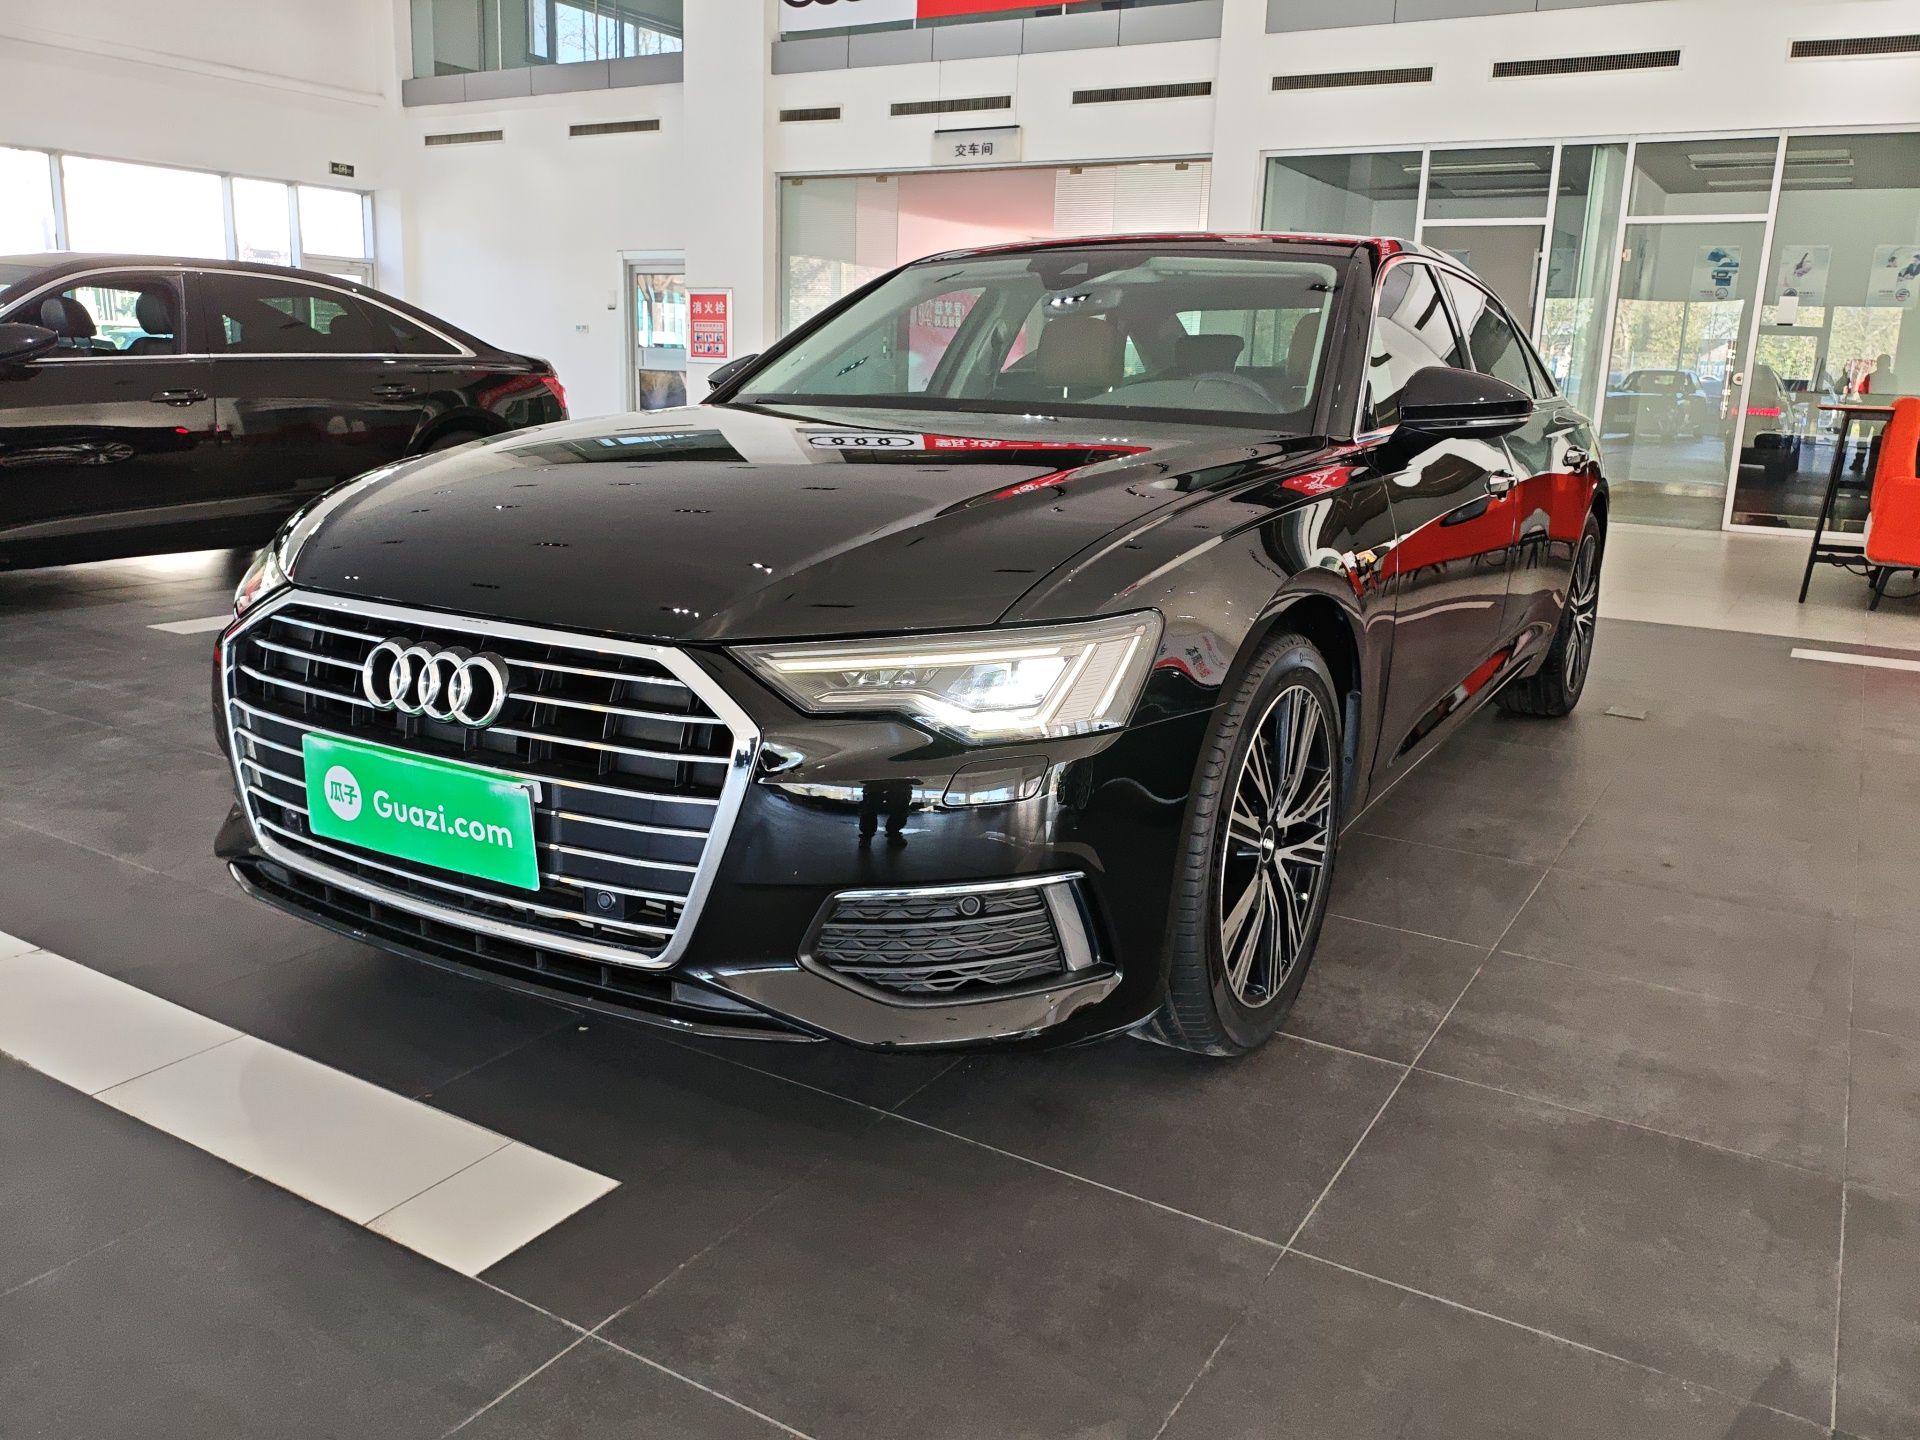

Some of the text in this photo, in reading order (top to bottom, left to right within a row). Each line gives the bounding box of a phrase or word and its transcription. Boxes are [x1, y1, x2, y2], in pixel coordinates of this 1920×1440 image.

[955, 142, 994, 157] 交车间
[692, 301, 726, 315] 消火栓
[329, 780, 358, 806] 瓜子
[372, 789, 514, 849] Guazi.com
